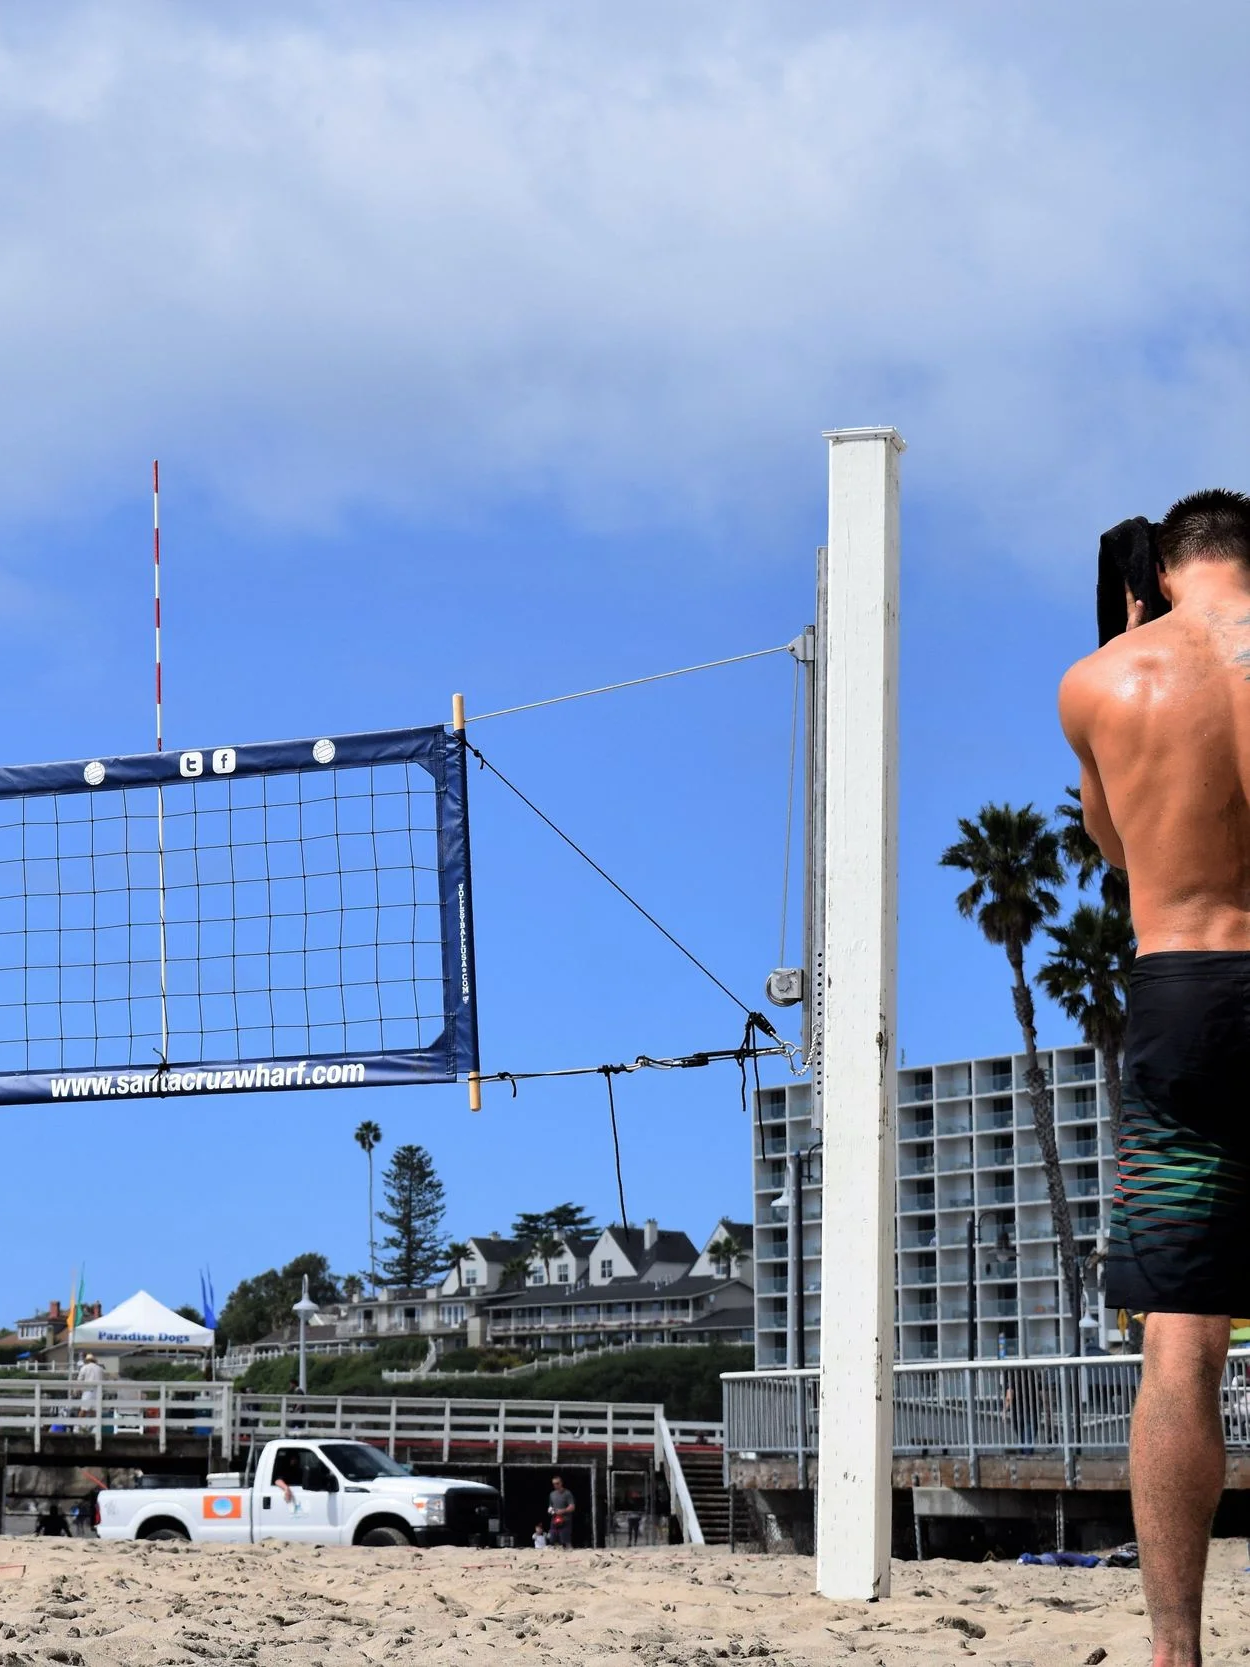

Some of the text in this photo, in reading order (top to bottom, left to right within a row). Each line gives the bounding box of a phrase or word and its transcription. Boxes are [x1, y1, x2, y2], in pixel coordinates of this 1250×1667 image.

[50, 1061, 366, 1098] www.santacruzwharf.com
[98, 1331, 190, 1343] Paradise Dogs
